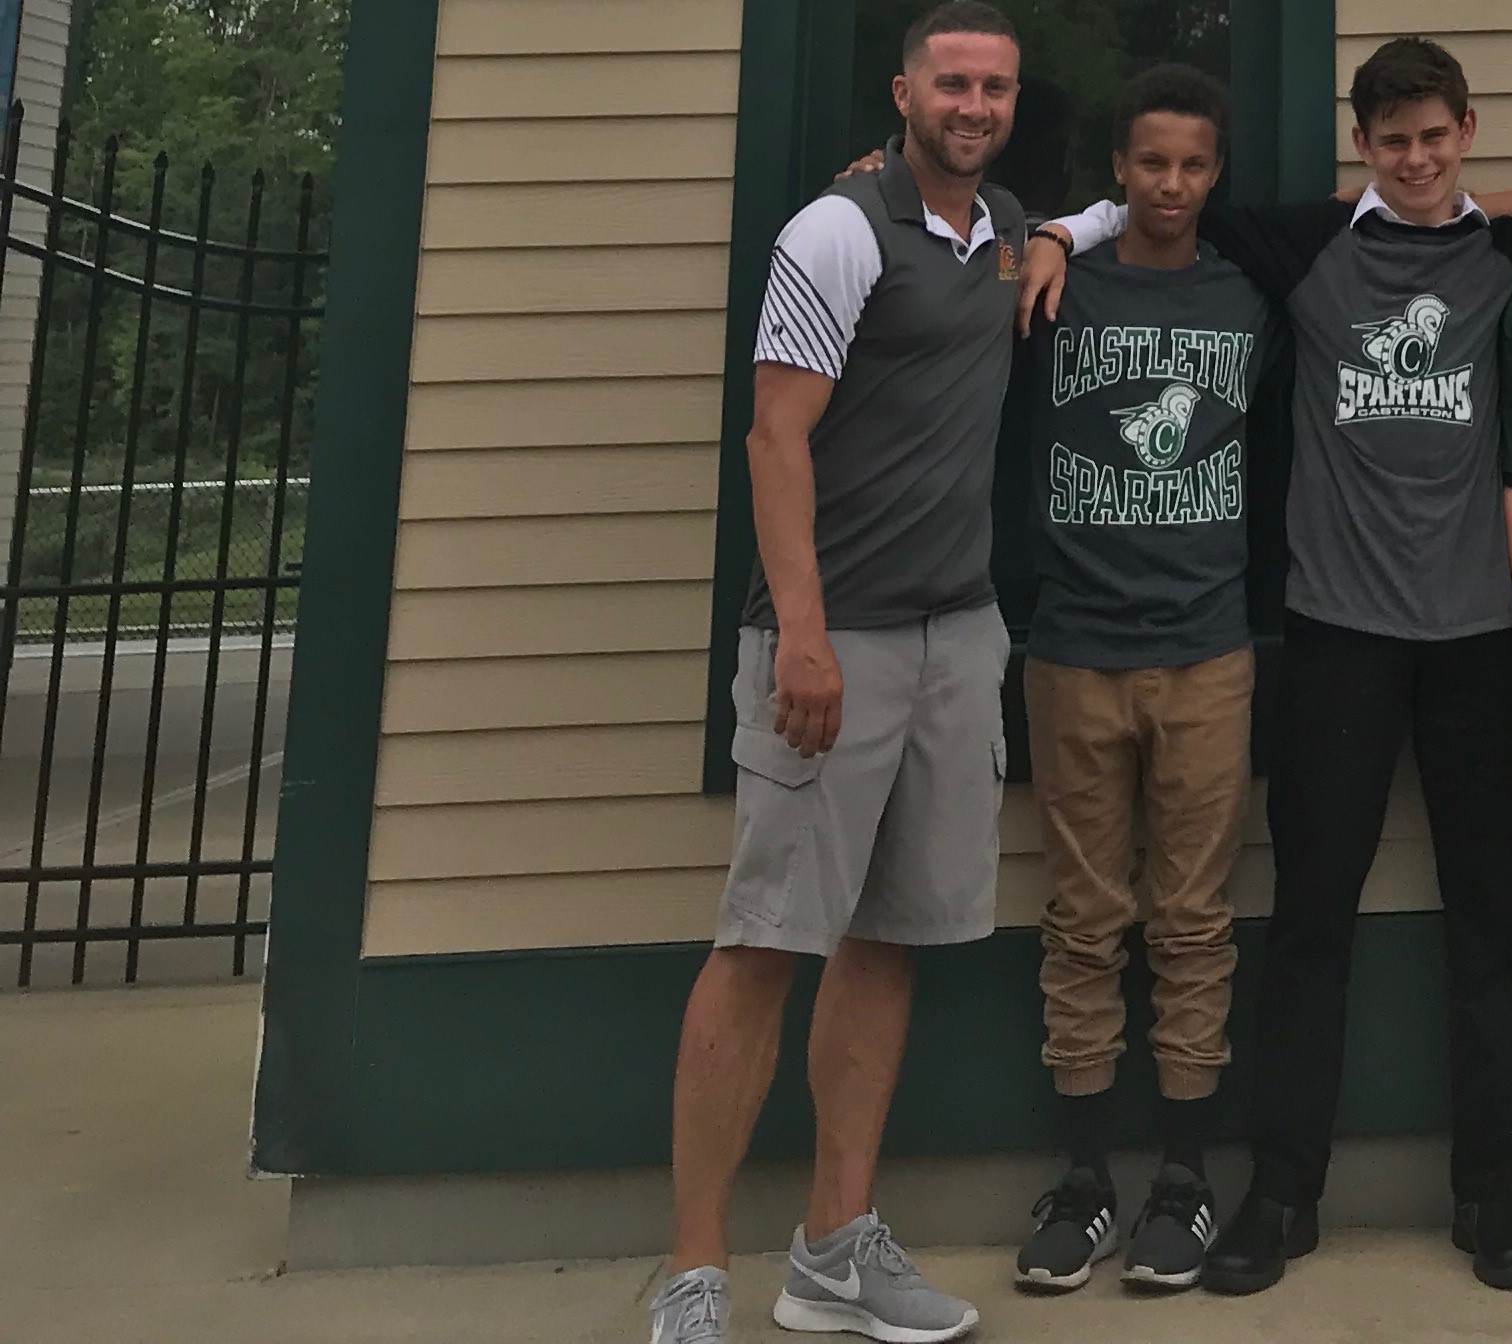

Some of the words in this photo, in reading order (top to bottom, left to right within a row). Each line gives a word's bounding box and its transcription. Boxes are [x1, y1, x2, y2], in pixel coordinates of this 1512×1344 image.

[1052, 326, 1254, 413] CASTLETON
[1401, 337, 1424, 373] C
[1338, 367, 1472, 421] SPARTANS
[1357, 407, 1453, 419] CASTLETON
[1155, 421, 1176, 454] C
[1050, 439, 1242, 525] SPARTANS
